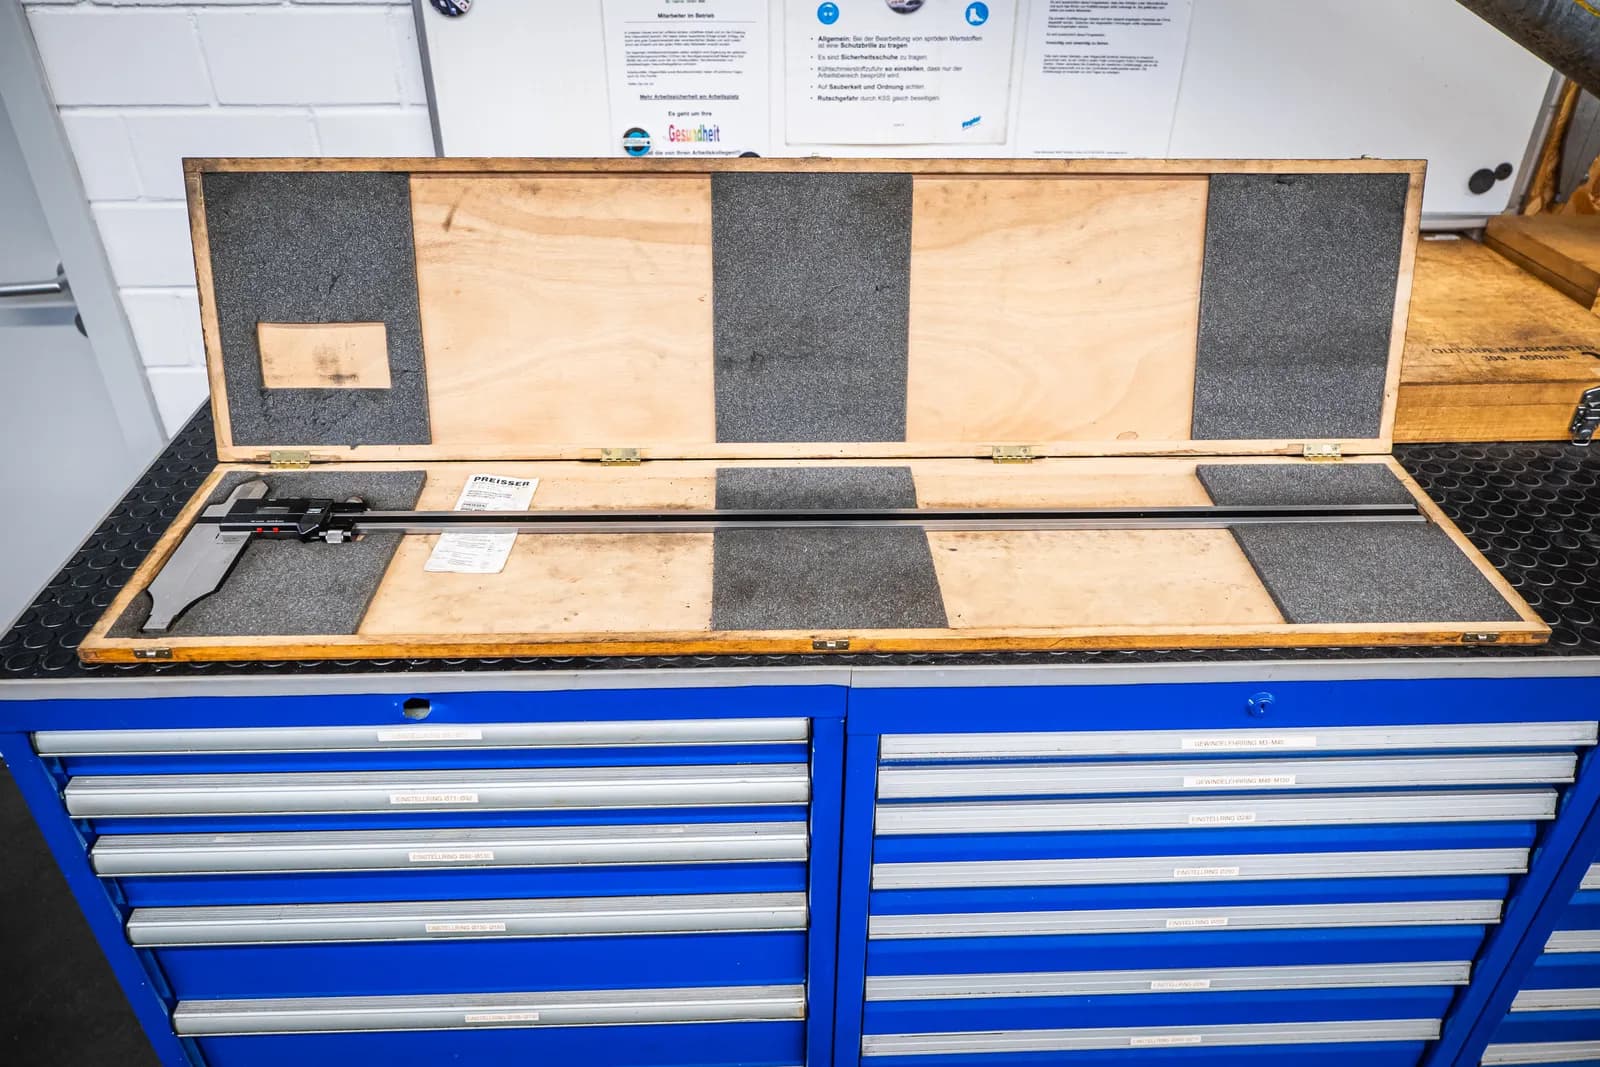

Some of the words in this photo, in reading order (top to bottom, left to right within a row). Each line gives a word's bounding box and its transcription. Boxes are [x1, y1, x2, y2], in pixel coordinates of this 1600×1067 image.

[668, 124, 720, 142] Gesundheit
[1498, 345, 1596, 354] MICROMETER
[473, 476, 530, 487] PREISSER
